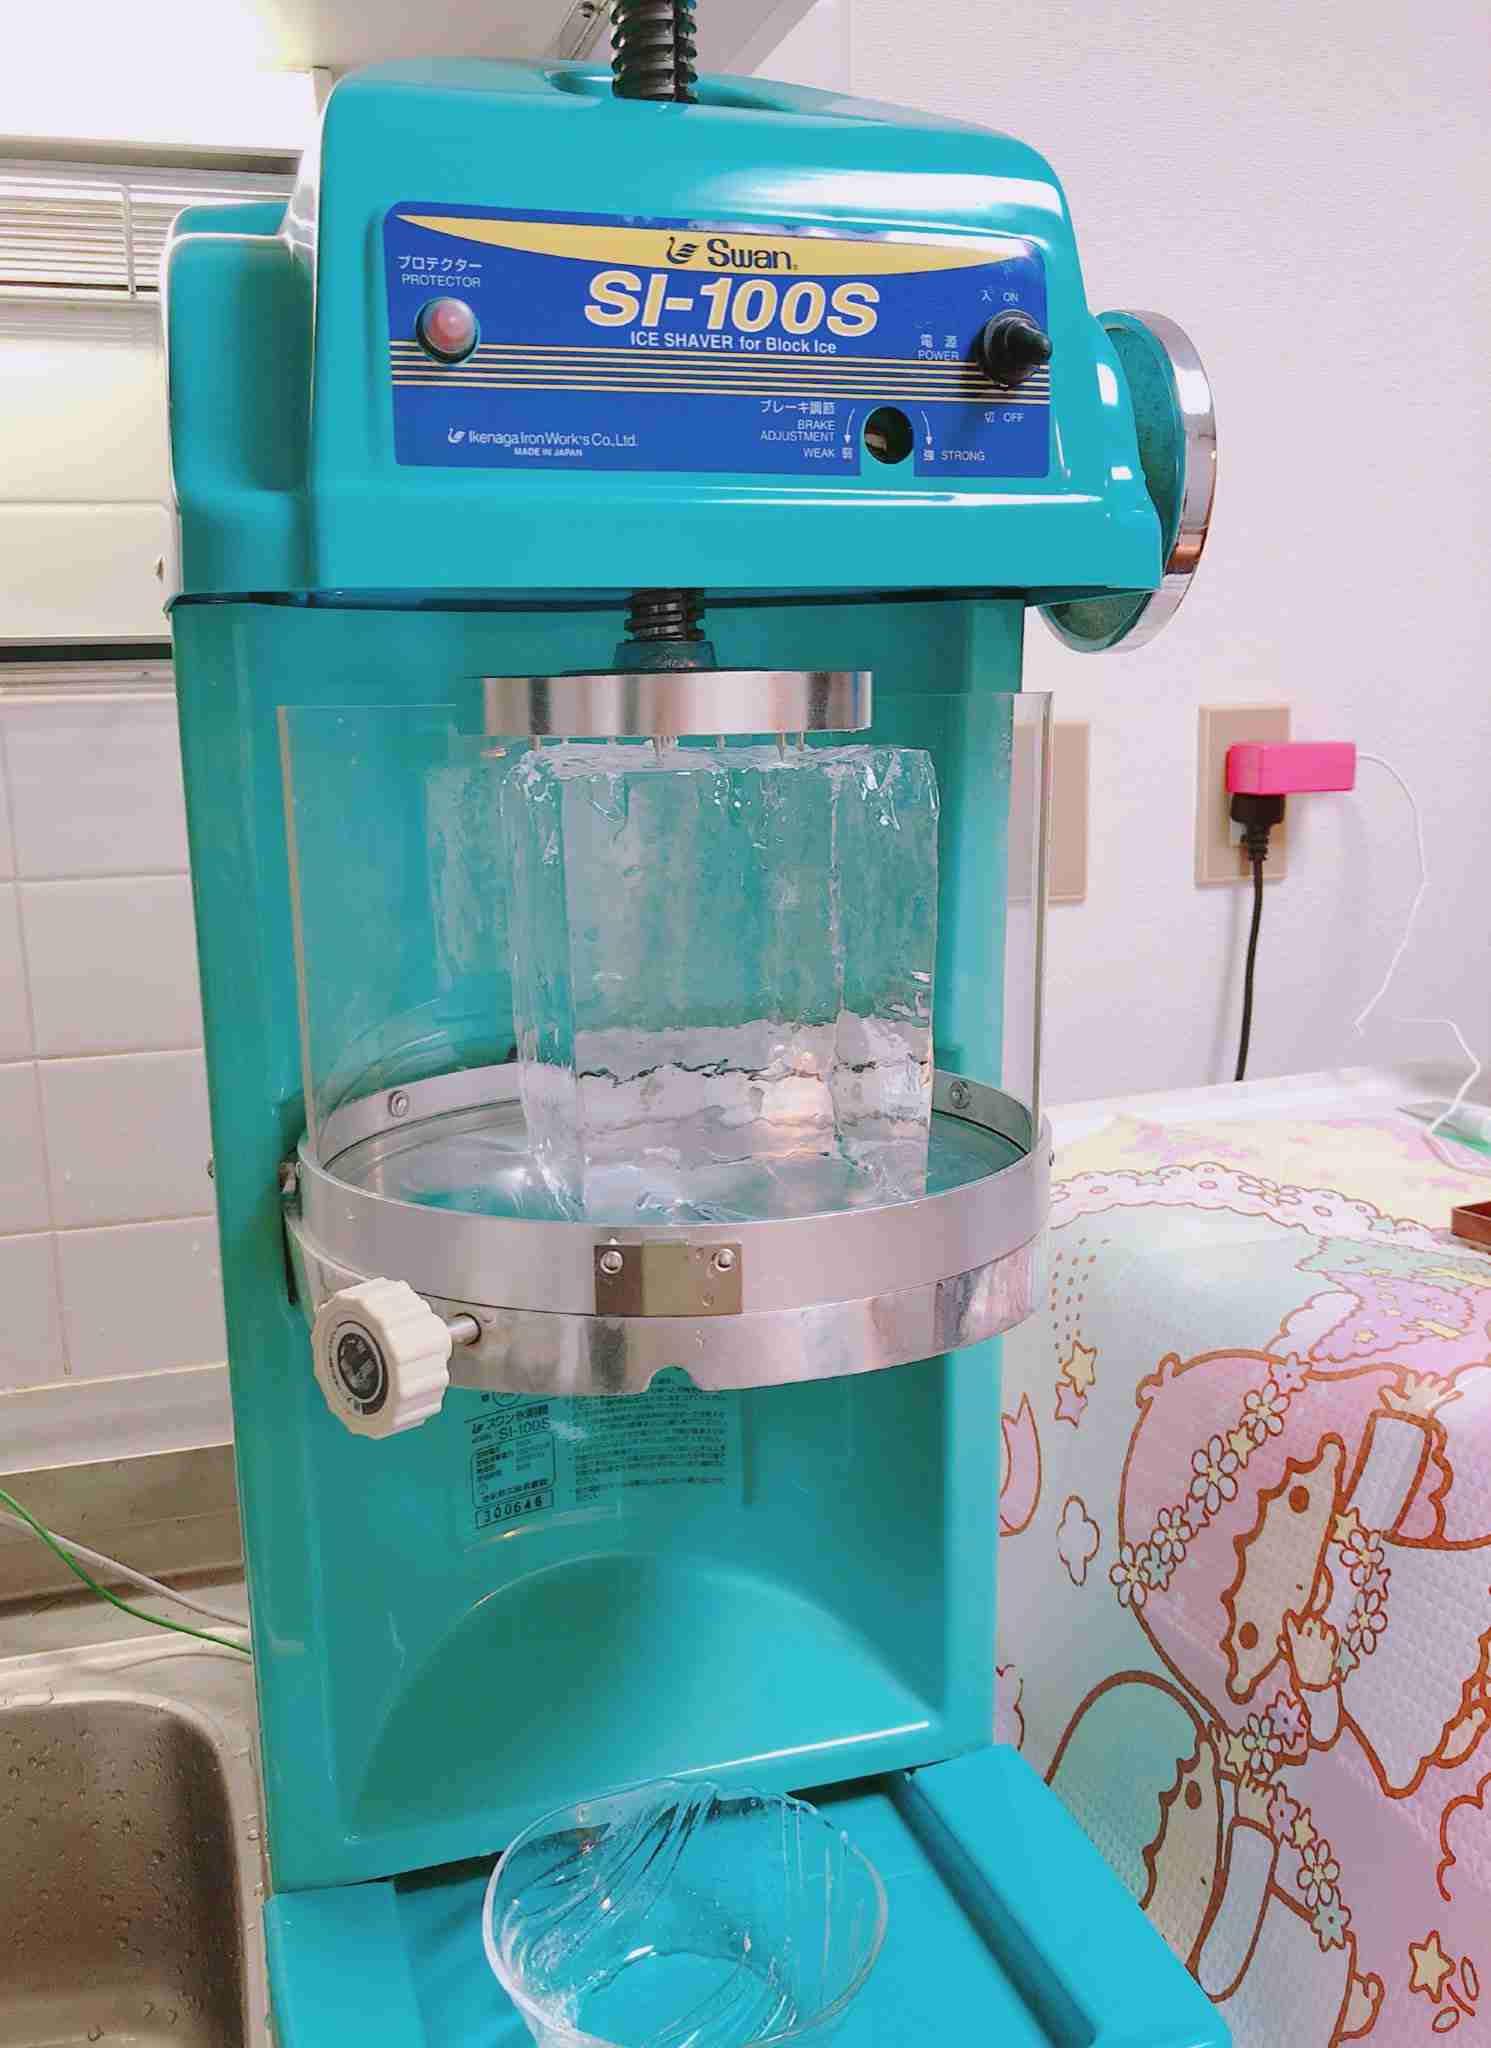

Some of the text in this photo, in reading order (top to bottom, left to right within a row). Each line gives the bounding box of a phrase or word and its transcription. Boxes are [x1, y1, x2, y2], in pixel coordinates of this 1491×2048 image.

[706, 238, 792, 270] Swan
[398, 255, 483, 272] プロテクター
[401, 273, 481, 288] PROTECTOR
[1002, 291, 1019, 303] ON
[584, 270, 880, 337] SI-100S
[630, 331, 837, 354] ICE SHAVER for Block Ice
[917, 350, 960, 361] POWER
[1003, 412, 1025, 423] OFF
[797, 419, 836, 431] BRAKE
[468, 430, 520, 446] Ikenaga
[520, 432, 545, 444] Iron
[759, 430, 836, 443] ADJUSTMENT
[513, 447, 583, 457] MADE IN JAPAN
[802, 447, 836, 459] WEAK
[941, 450, 986, 462] STRONG
